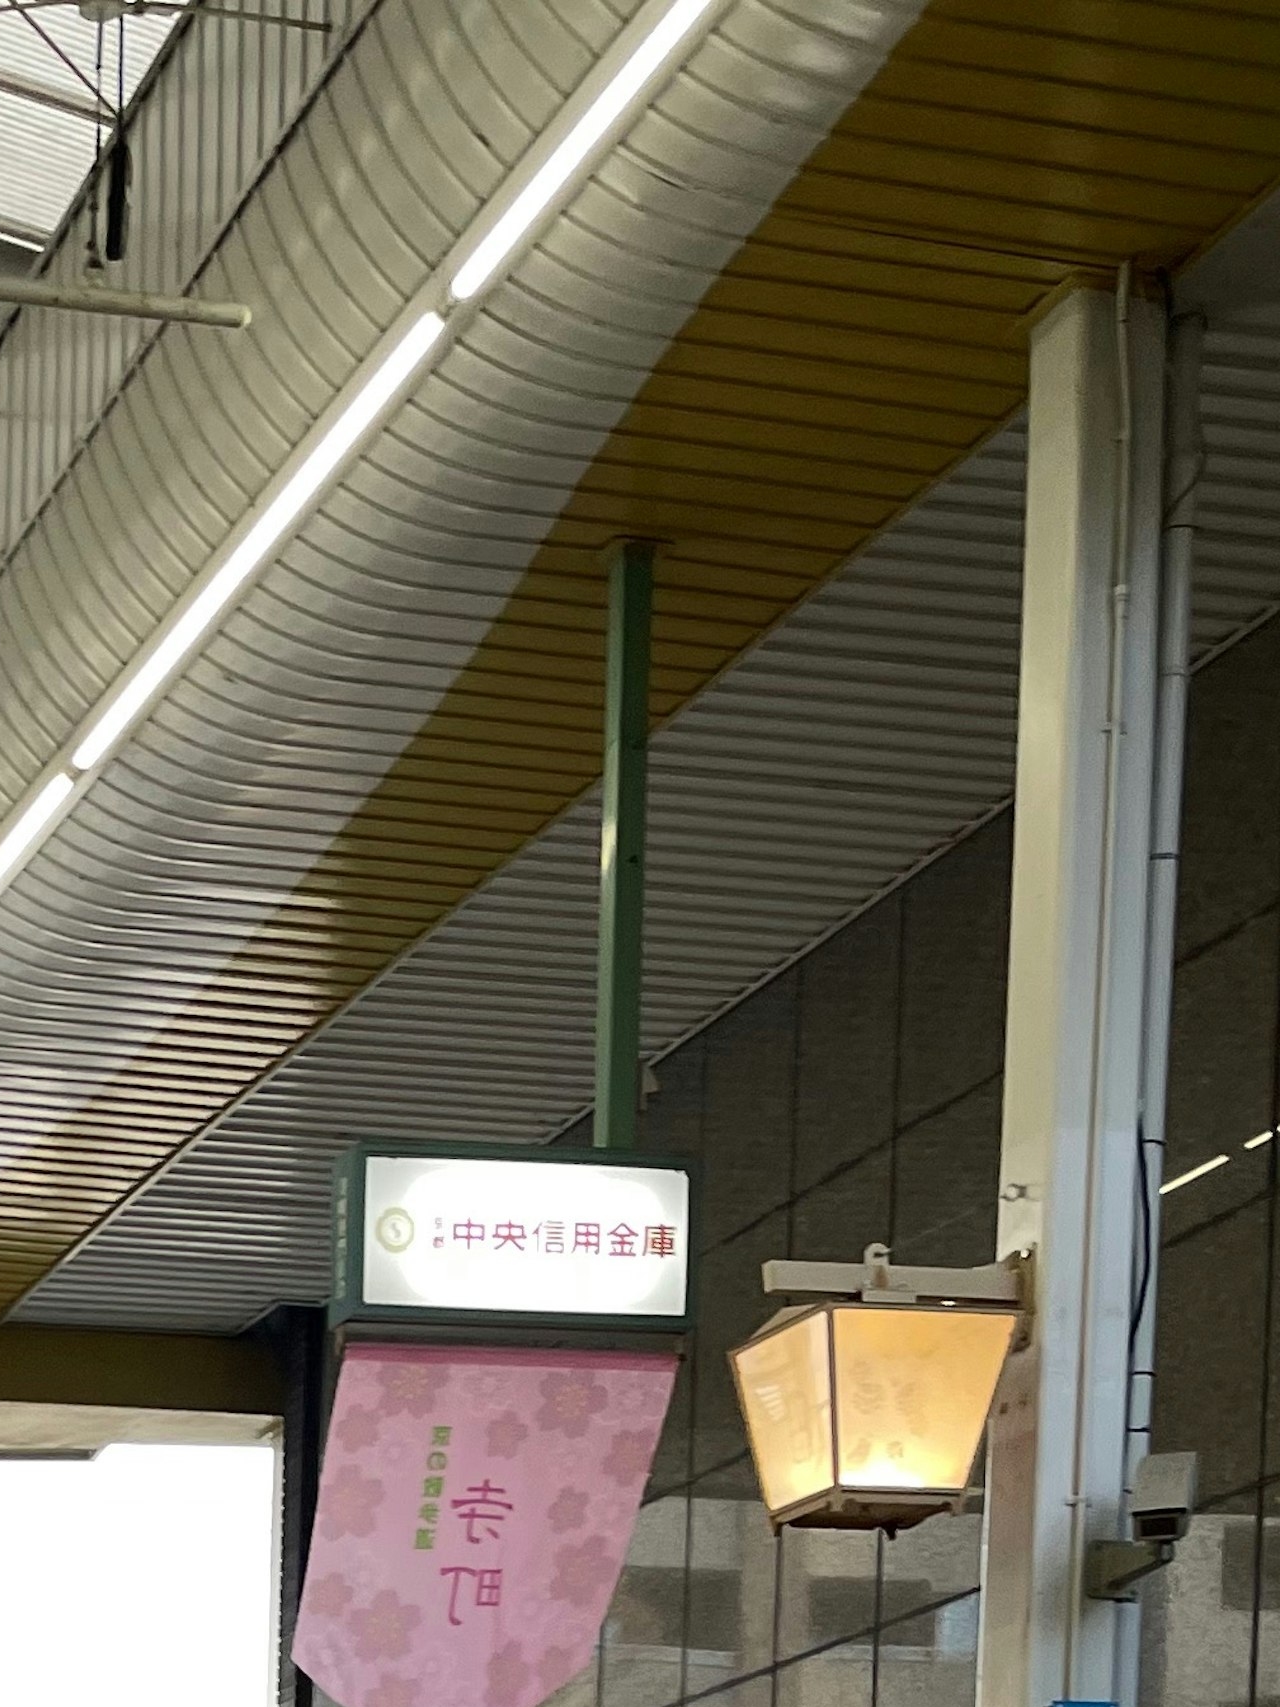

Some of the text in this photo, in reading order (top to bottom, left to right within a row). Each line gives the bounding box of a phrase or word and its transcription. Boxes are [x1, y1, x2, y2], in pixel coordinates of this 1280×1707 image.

[453, 1218, 677, 1258] 中央信用金庫
